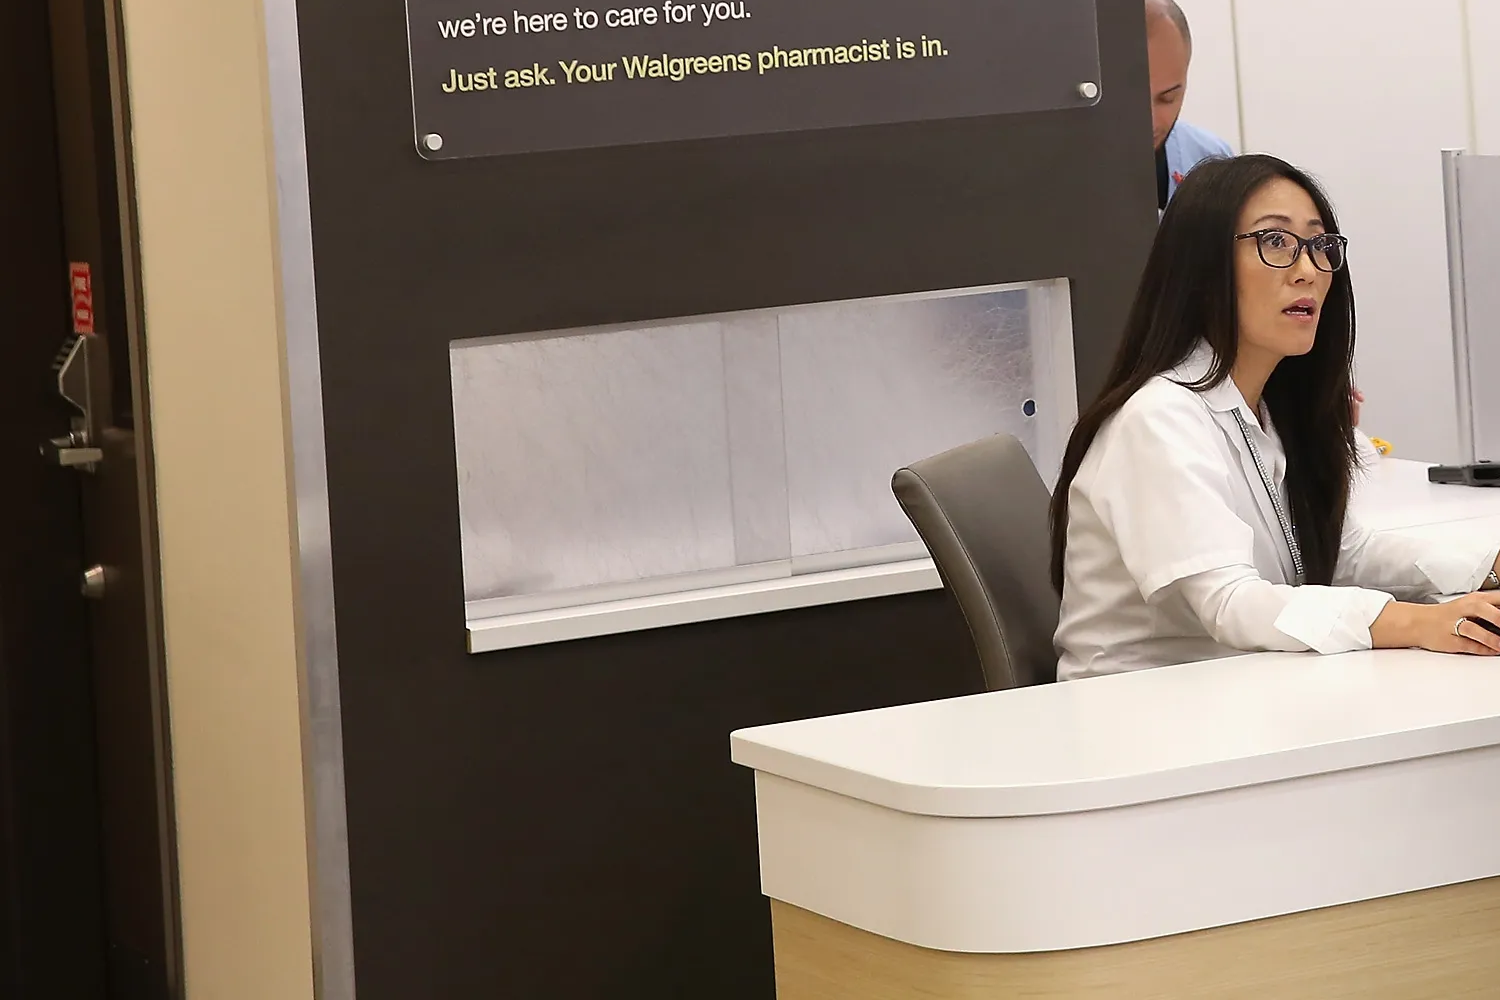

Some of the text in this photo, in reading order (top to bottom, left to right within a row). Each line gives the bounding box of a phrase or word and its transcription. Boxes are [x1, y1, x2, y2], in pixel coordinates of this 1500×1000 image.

[437, 0, 751, 39] we're here to care for you.
[441, 34, 949, 93] Just ask. Your Walgreens pharmacist is in.
